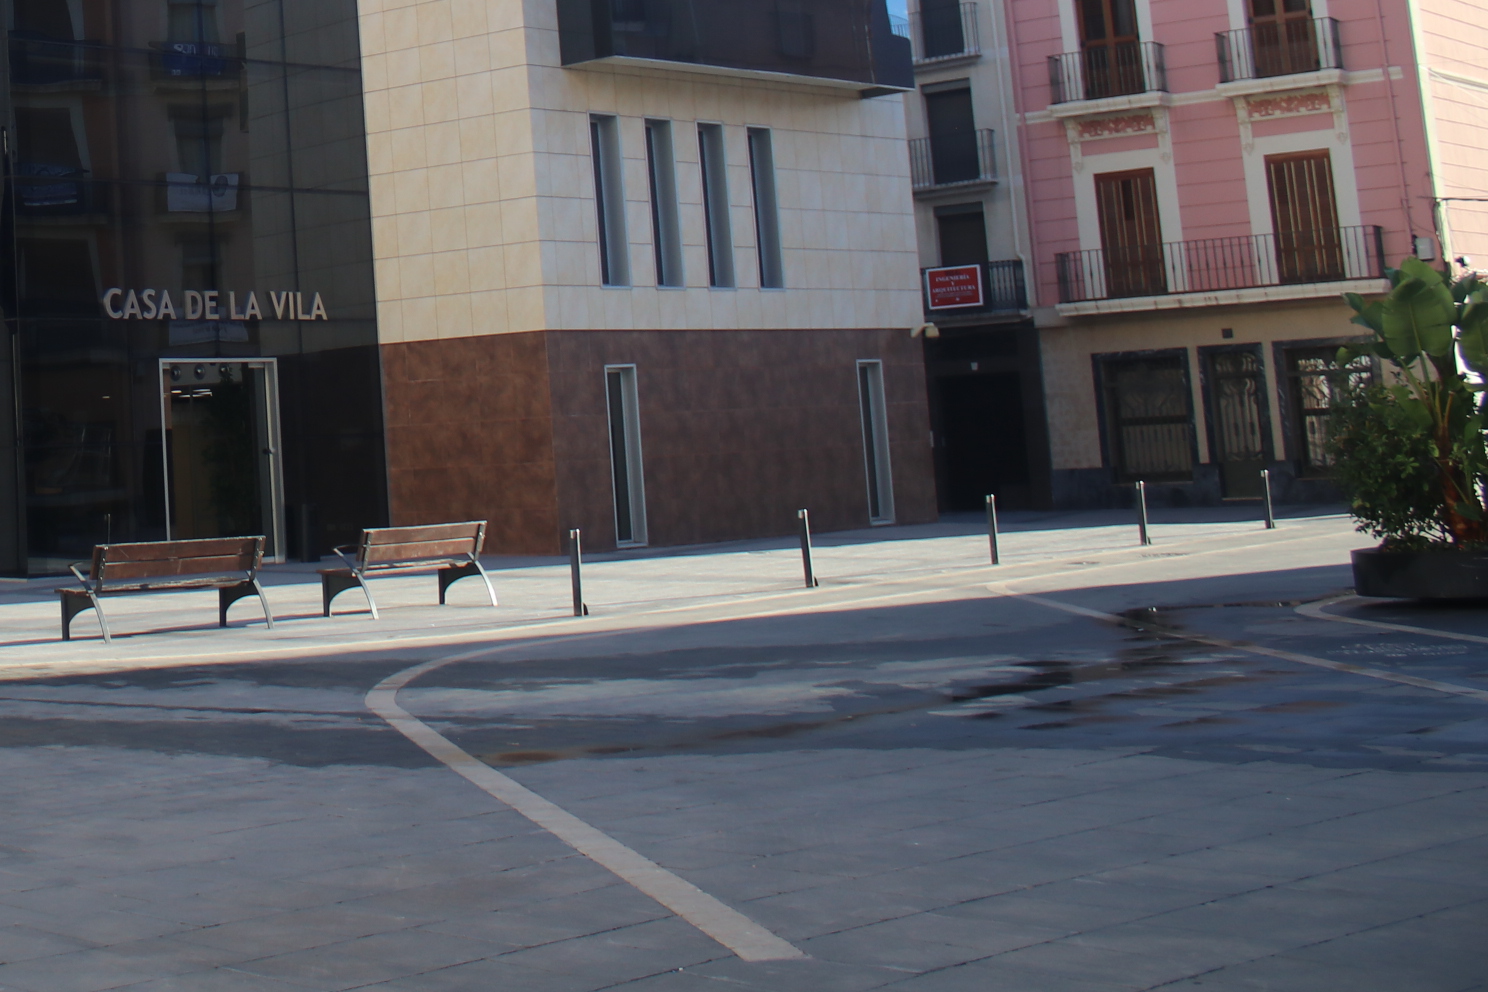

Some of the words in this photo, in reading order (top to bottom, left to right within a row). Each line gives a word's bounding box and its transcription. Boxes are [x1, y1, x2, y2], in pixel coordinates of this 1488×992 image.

[102, 287, 177, 320] CASA
[184, 290, 220, 320] DE
[229, 291, 263, 320] LA
[270, 291, 329, 321] VILA
